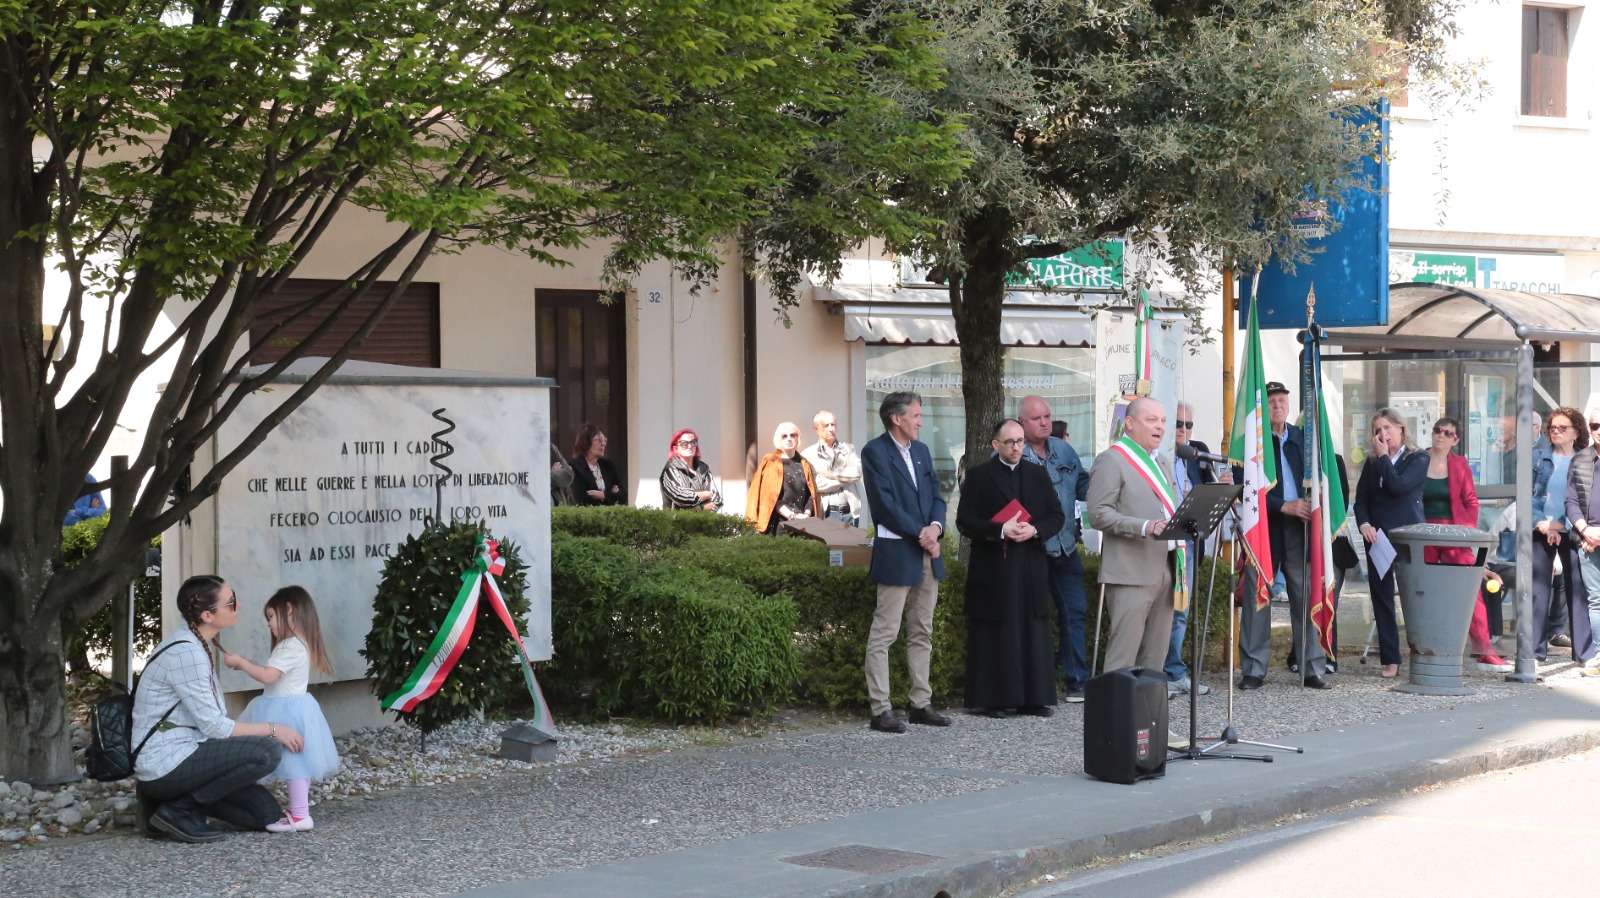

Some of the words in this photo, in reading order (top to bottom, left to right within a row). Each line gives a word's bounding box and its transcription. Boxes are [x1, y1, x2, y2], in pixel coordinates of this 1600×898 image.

[1025, 263, 1114, 287] NATURE
[1418, 260, 1428, 275] Il
[649, 291, 661, 303] 32
[341, 441, 348, 455] A
[354, 441, 385, 455] TUTTI
[394, 441, 397, 454] I
[407, 440, 449, 454] CADUTI
[247, 478, 268, 492] CHE
[275, 477, 307, 492] NELLE
[317, 476, 355, 490] GUERRE
[361, 475, 367, 490] E
[374, 474, 406, 489] NELLA
[413, 473, 447, 488] LOTTA
[453, 473, 462, 487] DI
[468, 471, 529, 486] LIBERAZIONE
[270, 511, 319, 527] FECERO
[327, 508, 402, 525] OLOCAUSTO
[410, 506, 433, 521] DELL
[487, 504, 508, 518] VITA
[283, 548, 301, 563] SIA
[309, 546, 325, 561] AD
[330, 545, 355, 560] ESSI
[365, 542, 391, 558] PACE
